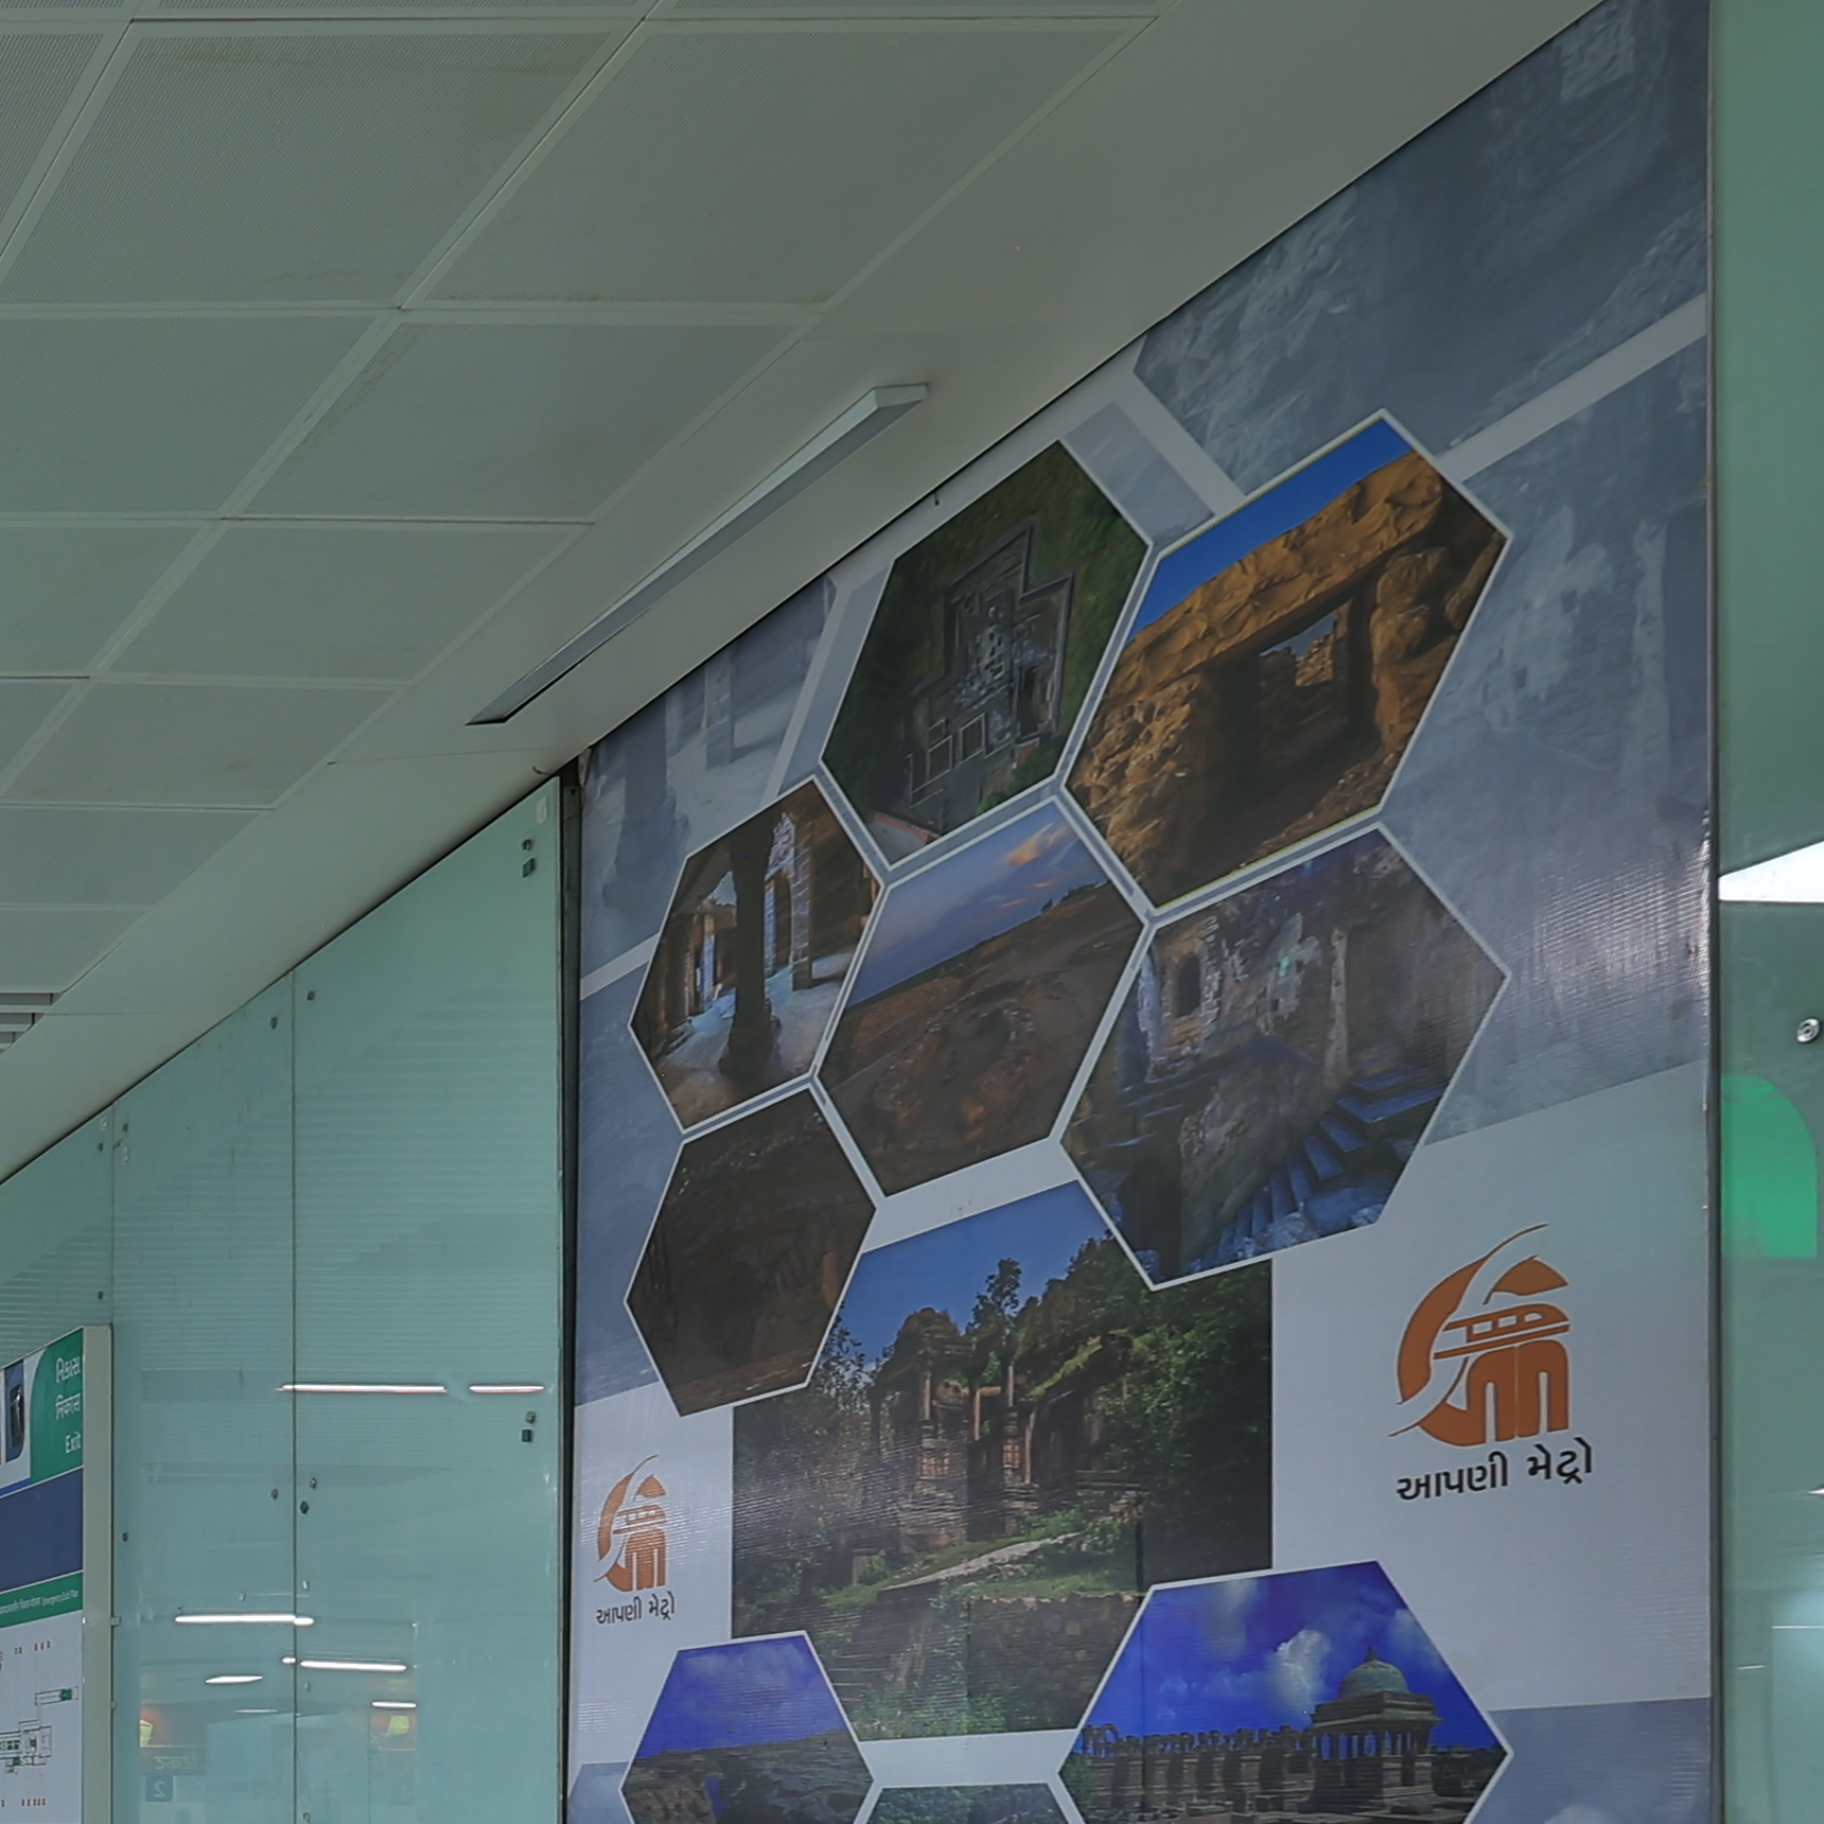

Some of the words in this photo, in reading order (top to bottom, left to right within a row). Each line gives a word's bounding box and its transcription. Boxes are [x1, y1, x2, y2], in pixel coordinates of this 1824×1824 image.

[1396, 1450, 1509, 1501] આપણી
[1526, 1436, 1593, 1485] મેટ્રો
[595, 1595, 642, 1625] આપણી
[648, 1590, 676, 1621] મેટ્રો
